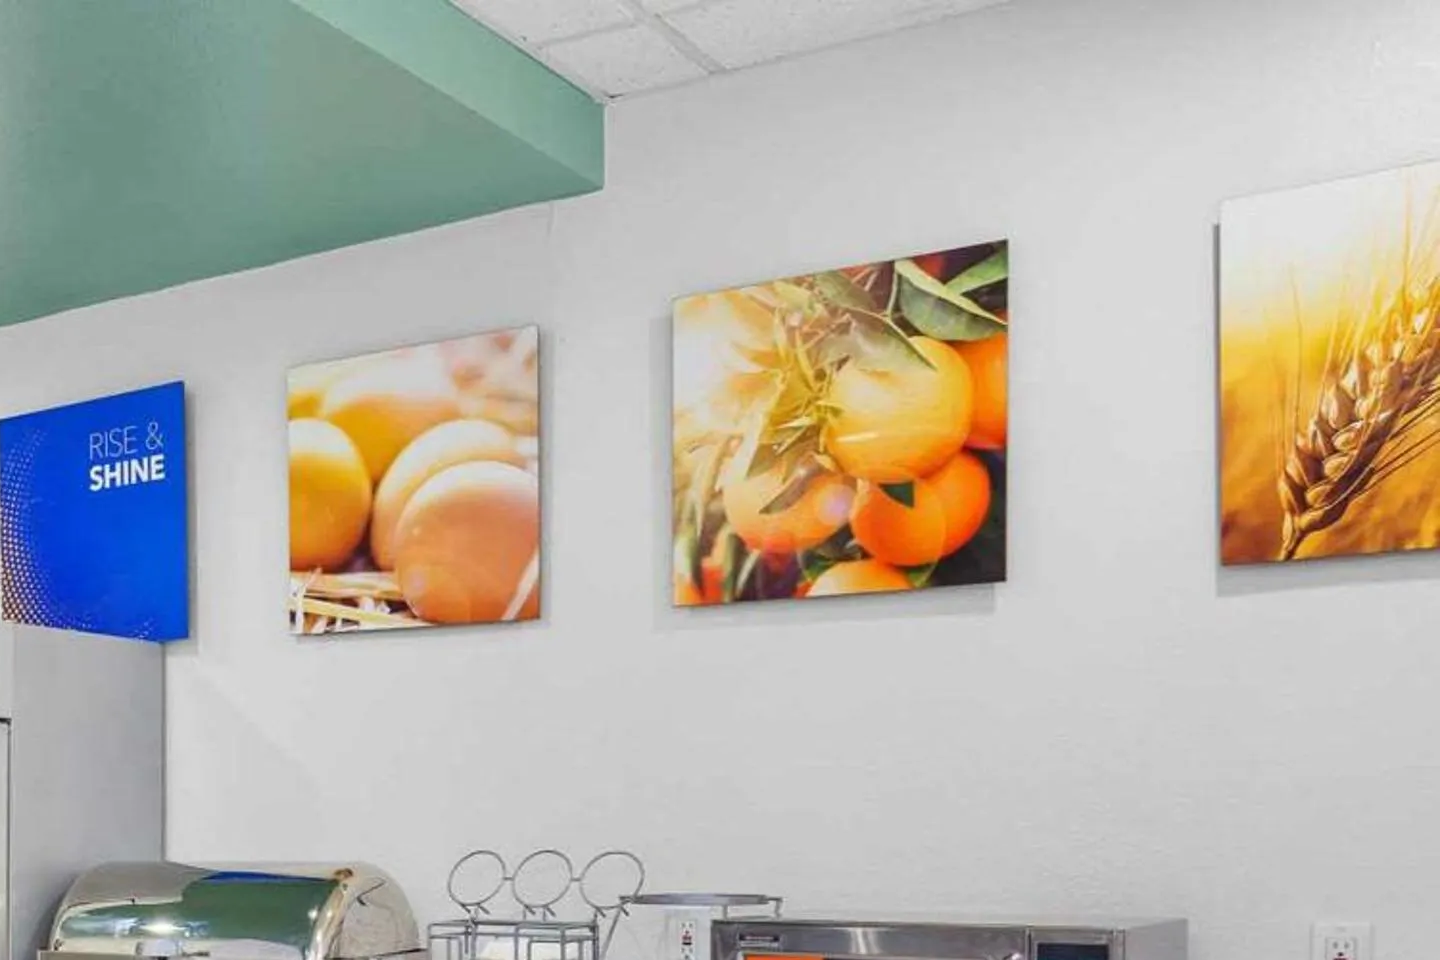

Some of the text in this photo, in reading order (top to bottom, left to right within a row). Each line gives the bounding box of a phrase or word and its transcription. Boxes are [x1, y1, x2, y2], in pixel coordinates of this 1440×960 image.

[89, 421, 164, 460] RISE &
[89, 453, 165, 491] SHINE
